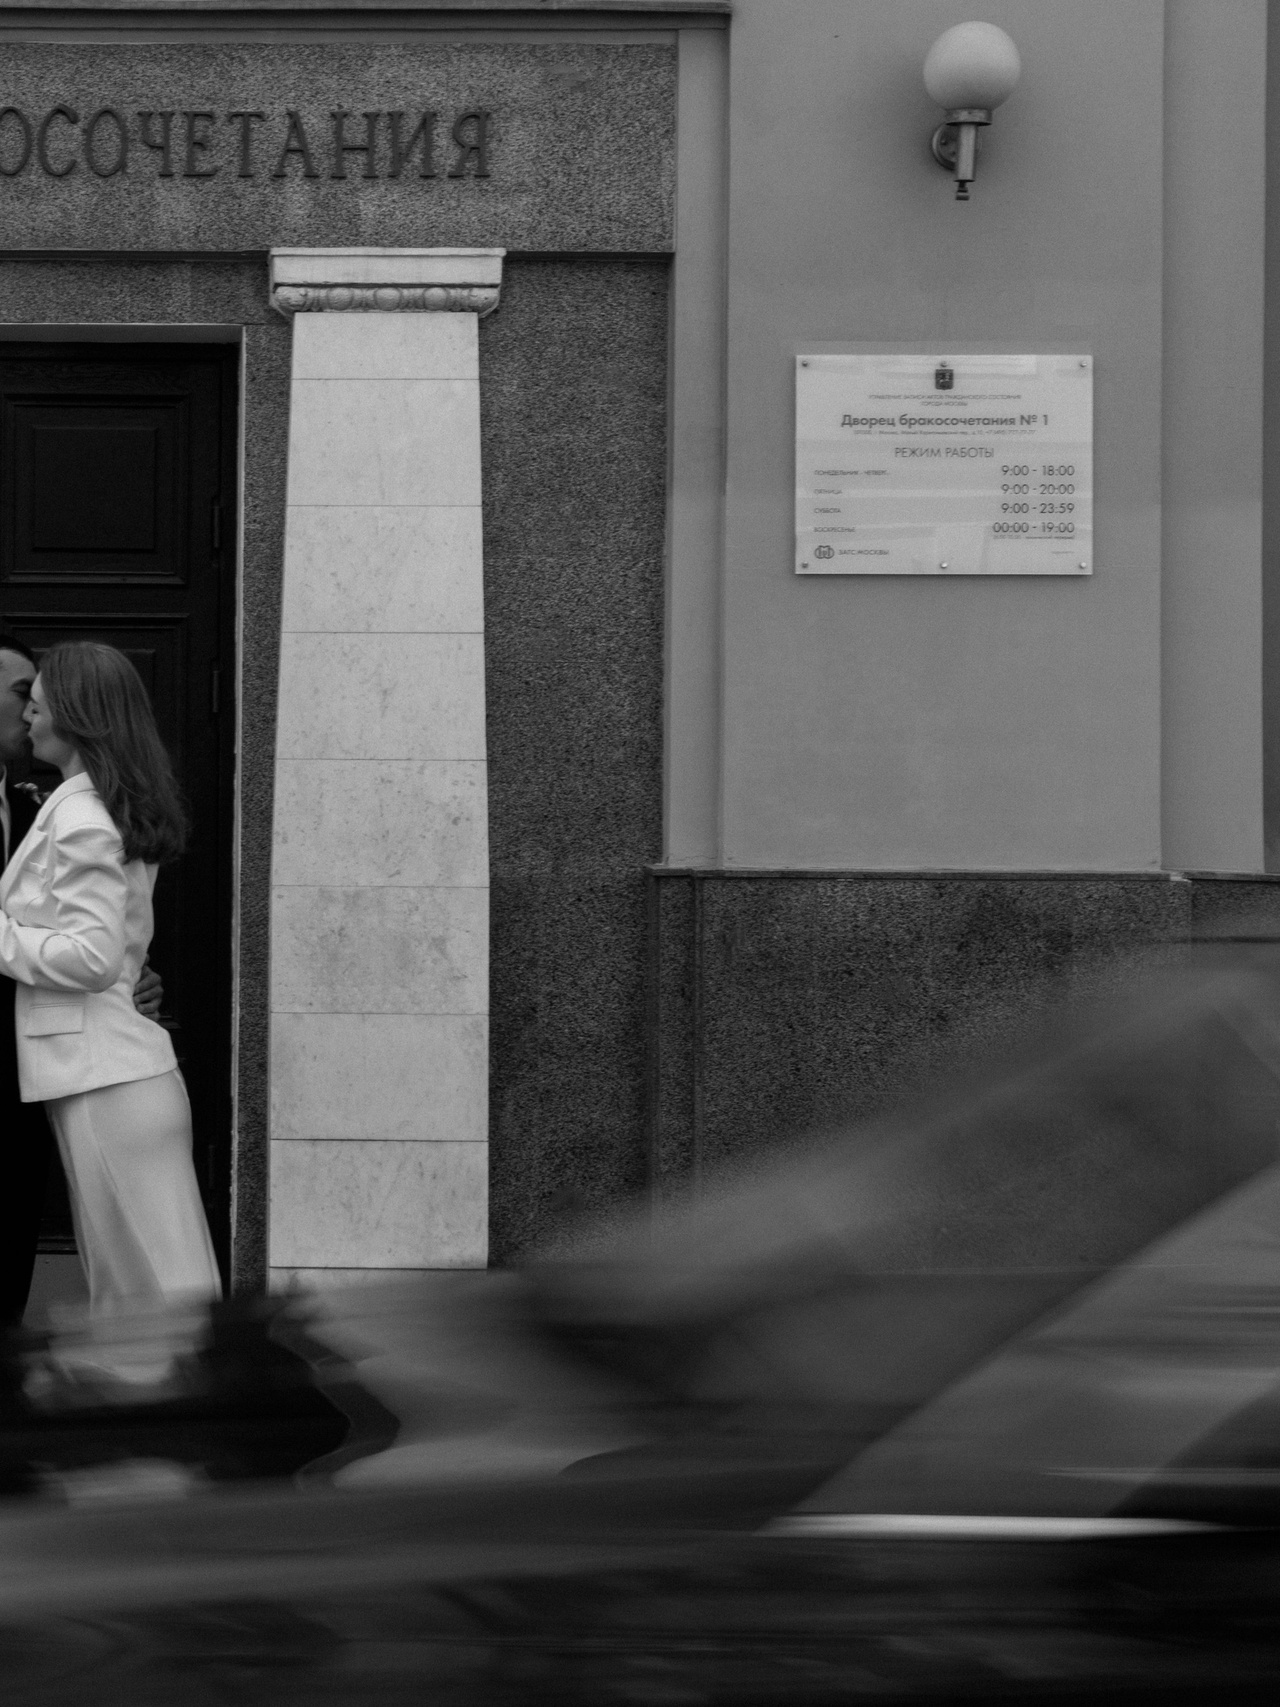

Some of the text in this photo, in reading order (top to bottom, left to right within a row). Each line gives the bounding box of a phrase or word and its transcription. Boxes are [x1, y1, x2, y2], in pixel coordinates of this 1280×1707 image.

[841, 413, 1049, 428] Дворец бракосочетания № 1
[894, 447, 994, 458] РЕЖИМ РАБОТЫ
[1001, 465, 1030, 476] 9:00
[1042, 465, 1075, 476] 18:00
[1001, 483, 1030, 495] 9:00
[1039, 483, 1075, 495] 20:00
[1001, 503, 1030, 514] 9:00
[1039, 503, 1075, 514] 23:59
[992, 522, 1030, 533] 00:00
[1042, 522, 1075, 533] 19:00
